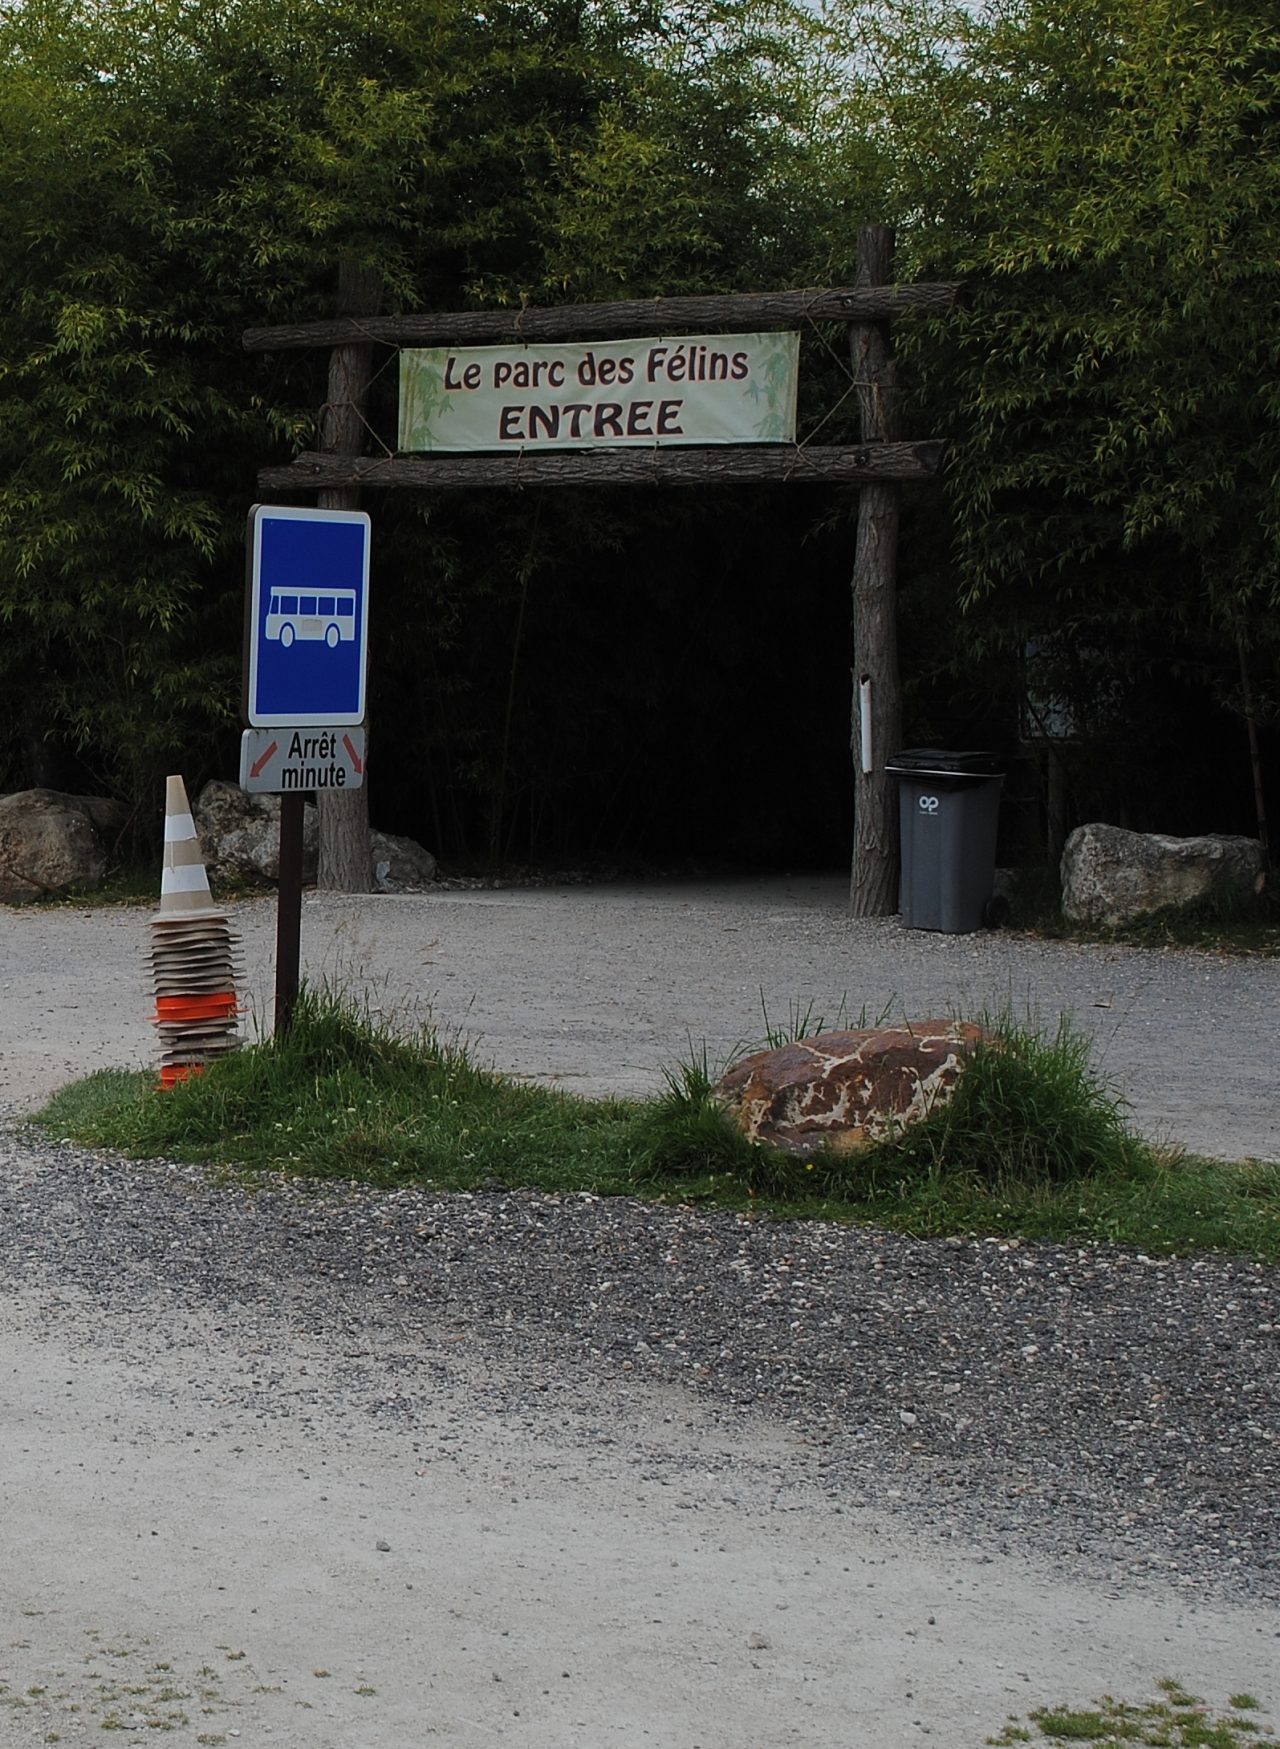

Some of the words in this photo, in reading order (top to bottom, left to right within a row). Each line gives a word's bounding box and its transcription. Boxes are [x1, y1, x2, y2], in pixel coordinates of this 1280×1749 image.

[444, 357, 481, 390] Le
[494, 359, 566, 388] parc
[577, 351, 635, 387] des
[646, 344, 750, 383] Félins
[498, 399, 685, 440] ENTREE
[288, 731, 337, 759] Arrêt
[282, 761, 346, 788] minute
